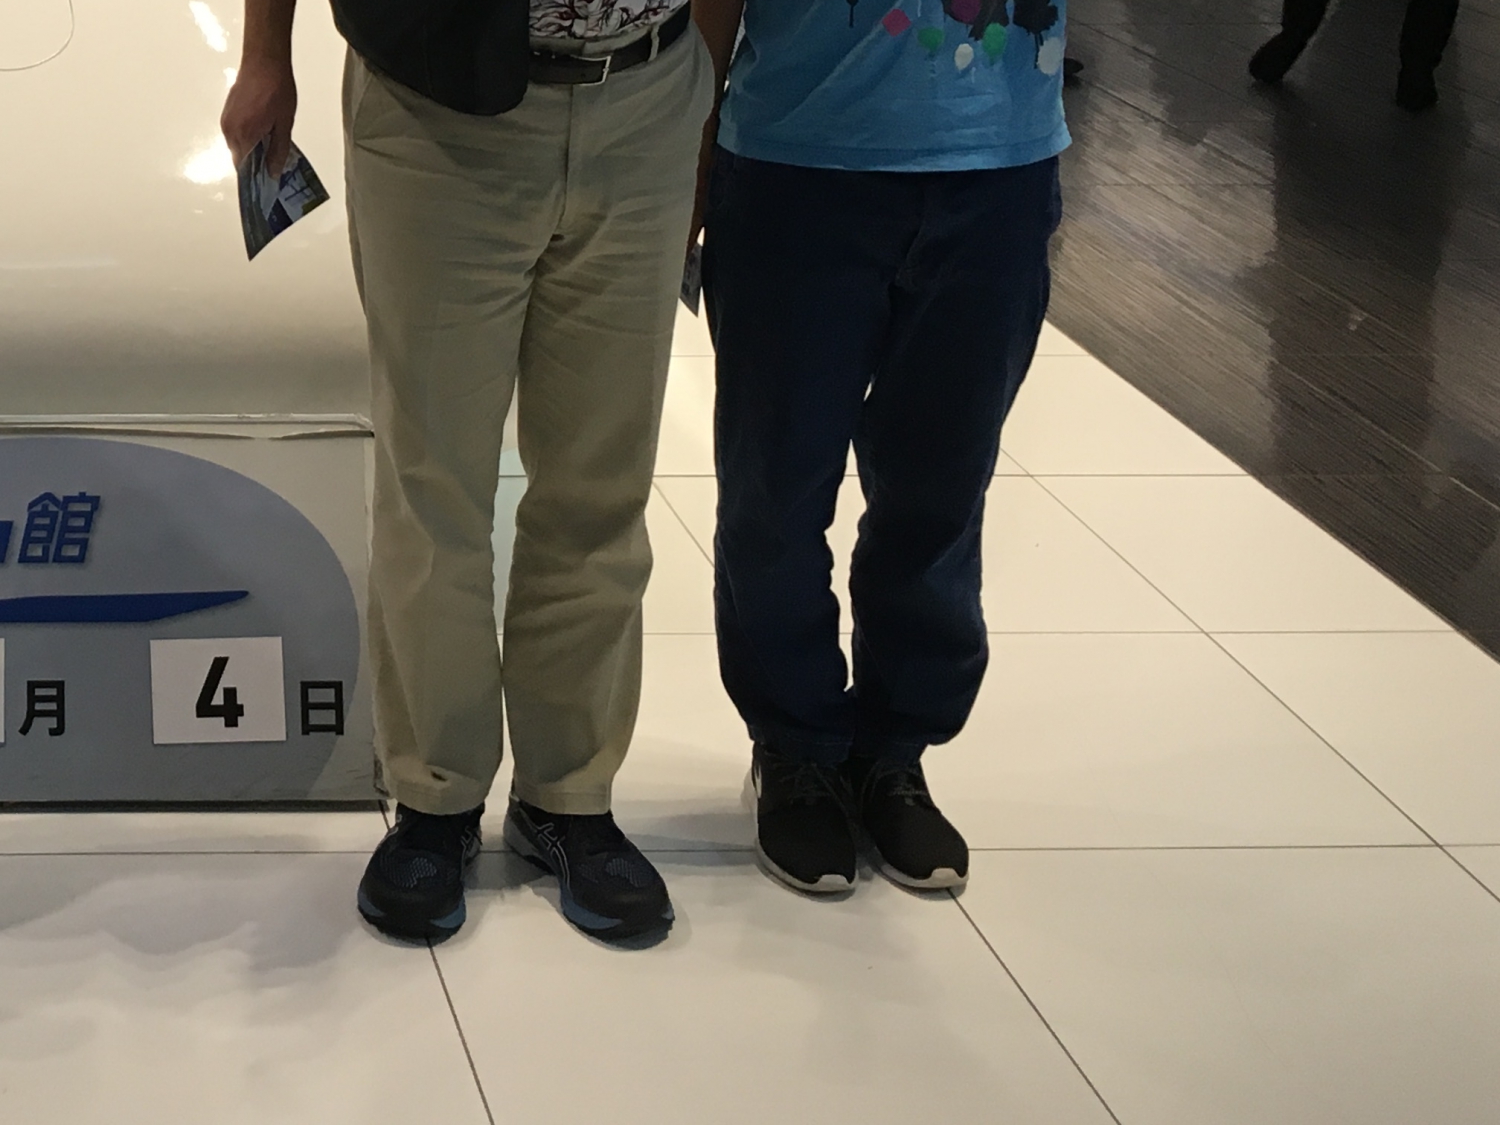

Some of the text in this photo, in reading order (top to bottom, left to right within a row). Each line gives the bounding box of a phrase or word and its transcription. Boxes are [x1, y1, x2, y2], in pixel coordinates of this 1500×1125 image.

[18, 679, 66, 737] 月
[194, 655, 245, 728] 4
[300, 679, 345, 737] 日
